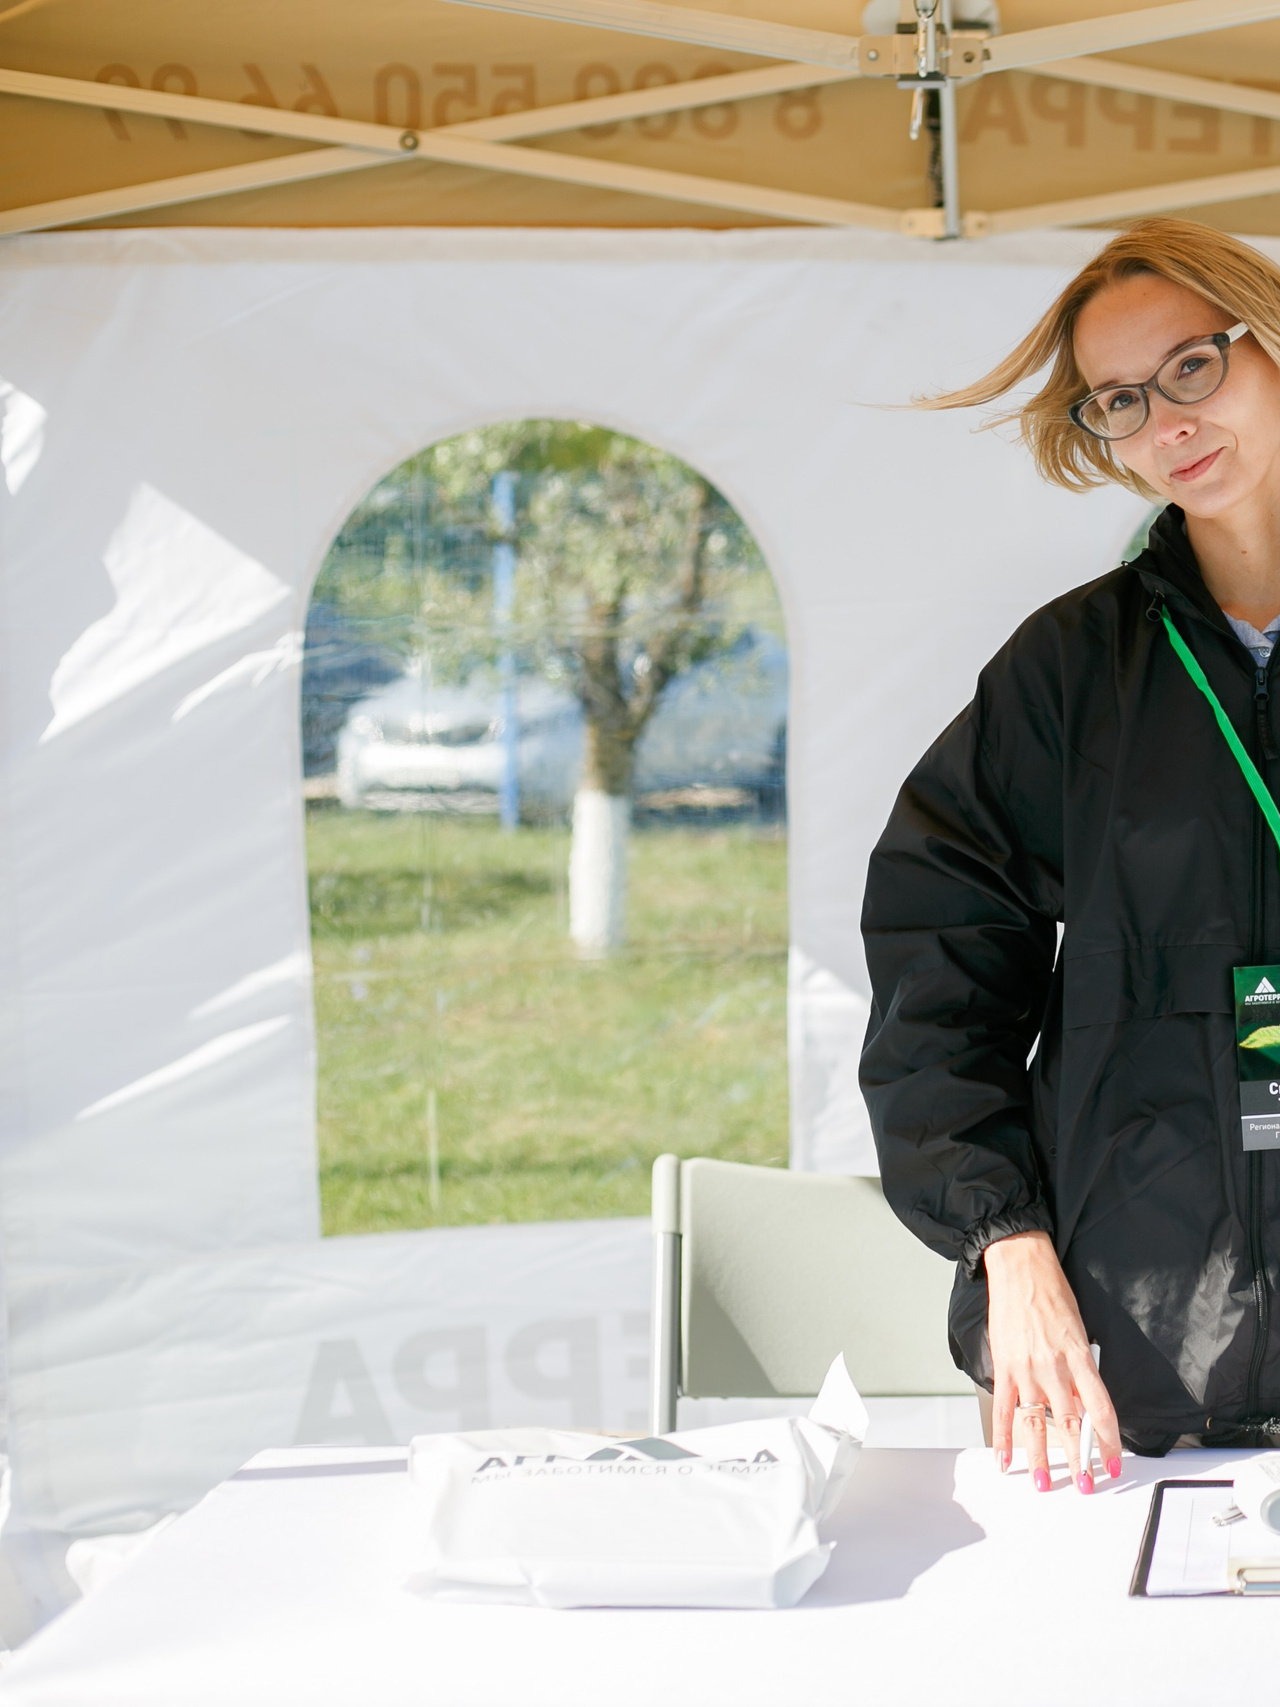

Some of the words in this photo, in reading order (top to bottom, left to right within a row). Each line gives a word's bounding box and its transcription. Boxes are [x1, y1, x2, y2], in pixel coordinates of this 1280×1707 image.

[471, 1471, 511, 1485] МЫ
[521, 1464, 667, 1478] ЗАБОТИМСЯ
[678, 1465, 693, 1476] О
